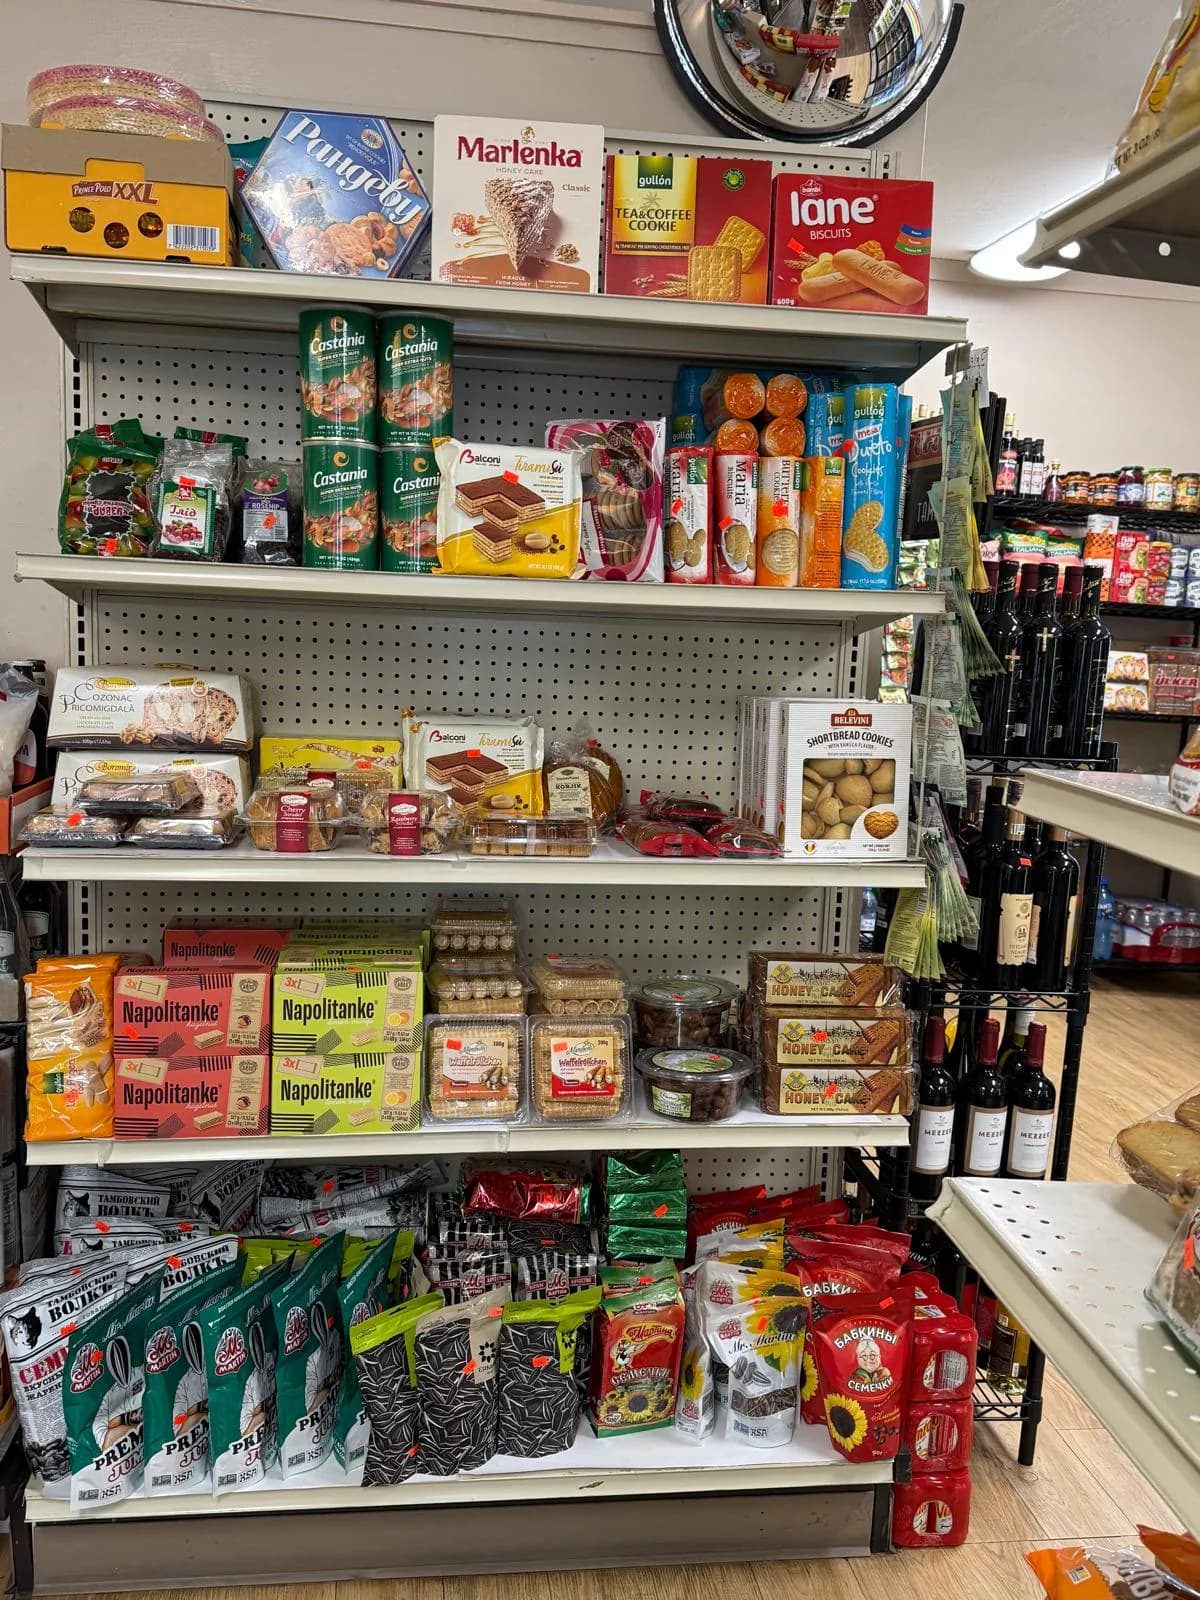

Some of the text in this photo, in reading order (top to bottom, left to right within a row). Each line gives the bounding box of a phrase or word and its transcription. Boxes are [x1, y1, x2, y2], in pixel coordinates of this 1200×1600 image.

[457, 136, 582, 168] Marlenka
[524, 168, 544, 176] CAKE
[562, 184, 591, 192] Classic
[639, 175, 671, 187] gullón
[73, 182, 158, 204] PRINCE POLO XXL
[615, 208, 692, 221] TEA&COFFEE
[629, 220, 677, 232] COOKIE
[810, 228, 851, 240] BISCUITS
[311, 331, 365, 354] Castania
[385, 338, 438, 361] Castania
[828, 415, 844, 425] gull
[460, 449, 501, 464] Balconi
[314, 467, 367, 488] Castania
[687, 457, 697, 484] gullón
[393, 473, 441, 493] Castani
[672, 459, 684, 502] Maria
[735, 460, 748, 505] Maria
[252, 502, 280, 510] ROSEHIP
[1155, 672, 1199, 687] ÜLKER
[74, 683, 134, 702] COZONAC
[834, 716, 870, 725] BELEVINI
[429, 730, 466, 743] Balconi
[807, 731, 894, 748] SHORTBREAD COOKIES
[281, 805, 305, 814] Cherry
[171, 942, 235, 961] Napolitanke
[124, 979, 137, 990] 3x
[285, 977, 298, 988] 3x
[772, 985, 854, 998] HONEY CAKE
[123, 1000, 219, 1028] Napolitanke
[283, 997, 375, 1025] Napolitanke
[782, 1043, 867, 1056] HONEY CAKE
[124, 1060, 137, 1072] 3x
[282, 1057, 296, 1069] 3x
[123, 1080, 218, 1110] Napolitanke
[281, 1077, 372, 1106] Napolitanke
[785, 1092, 869, 1105] HONEY CAKE
[99, 1194, 161, 1207] ТАМБОВСКИЙ
[97, 1204, 158, 1217] ВОЛКЪ
[165, 1245, 230, 1274] АБОВСКИЙ
[163, 1256, 227, 1288] ВОЛКЪ
[47, 1271, 117, 1307] ТАМБОВСКИЙ
[802, 1283, 857, 1298] БАБКИ
[48, 1282, 113, 1322] ВОЛКЪ
[834, 1327, 898, 1349] БАБКИНЫ
[149, 1352, 178, 1373] MARTIN
[218, 1352, 246, 1373] MARTIN
[74, 1367, 102, 1391] MARTIN
[848, 1377, 894, 1393] СЕМЕЧКИ
